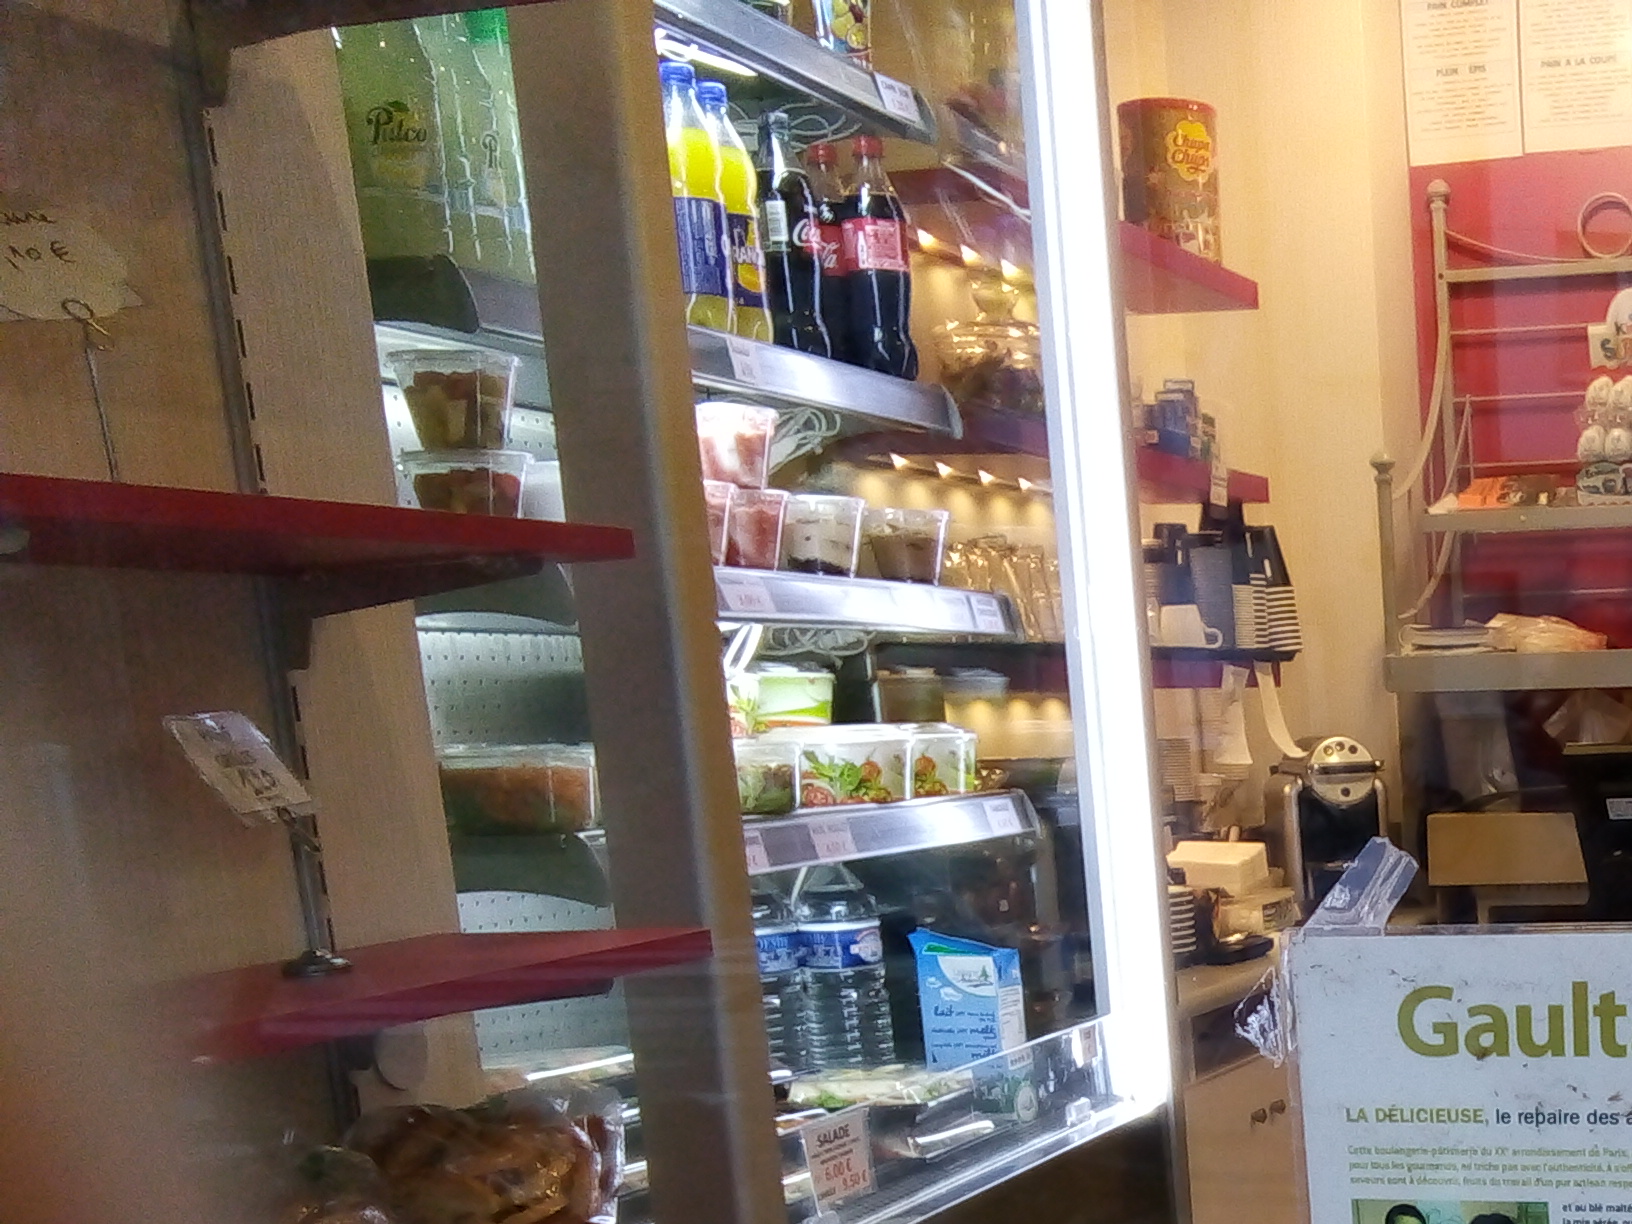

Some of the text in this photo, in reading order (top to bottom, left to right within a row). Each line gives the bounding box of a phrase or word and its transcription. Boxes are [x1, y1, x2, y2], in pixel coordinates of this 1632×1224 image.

[1346, 1108, 1367, 1126] LA
[1375, 1108, 1490, 1126] DÉLICIEUSE,
[1495, 1106, 1510, 1125] le
[1517, 1106, 1579, 1130] repaire
[1586, 1106, 1620, 1126] des
[816, 1123, 851, 1147] SALADE
